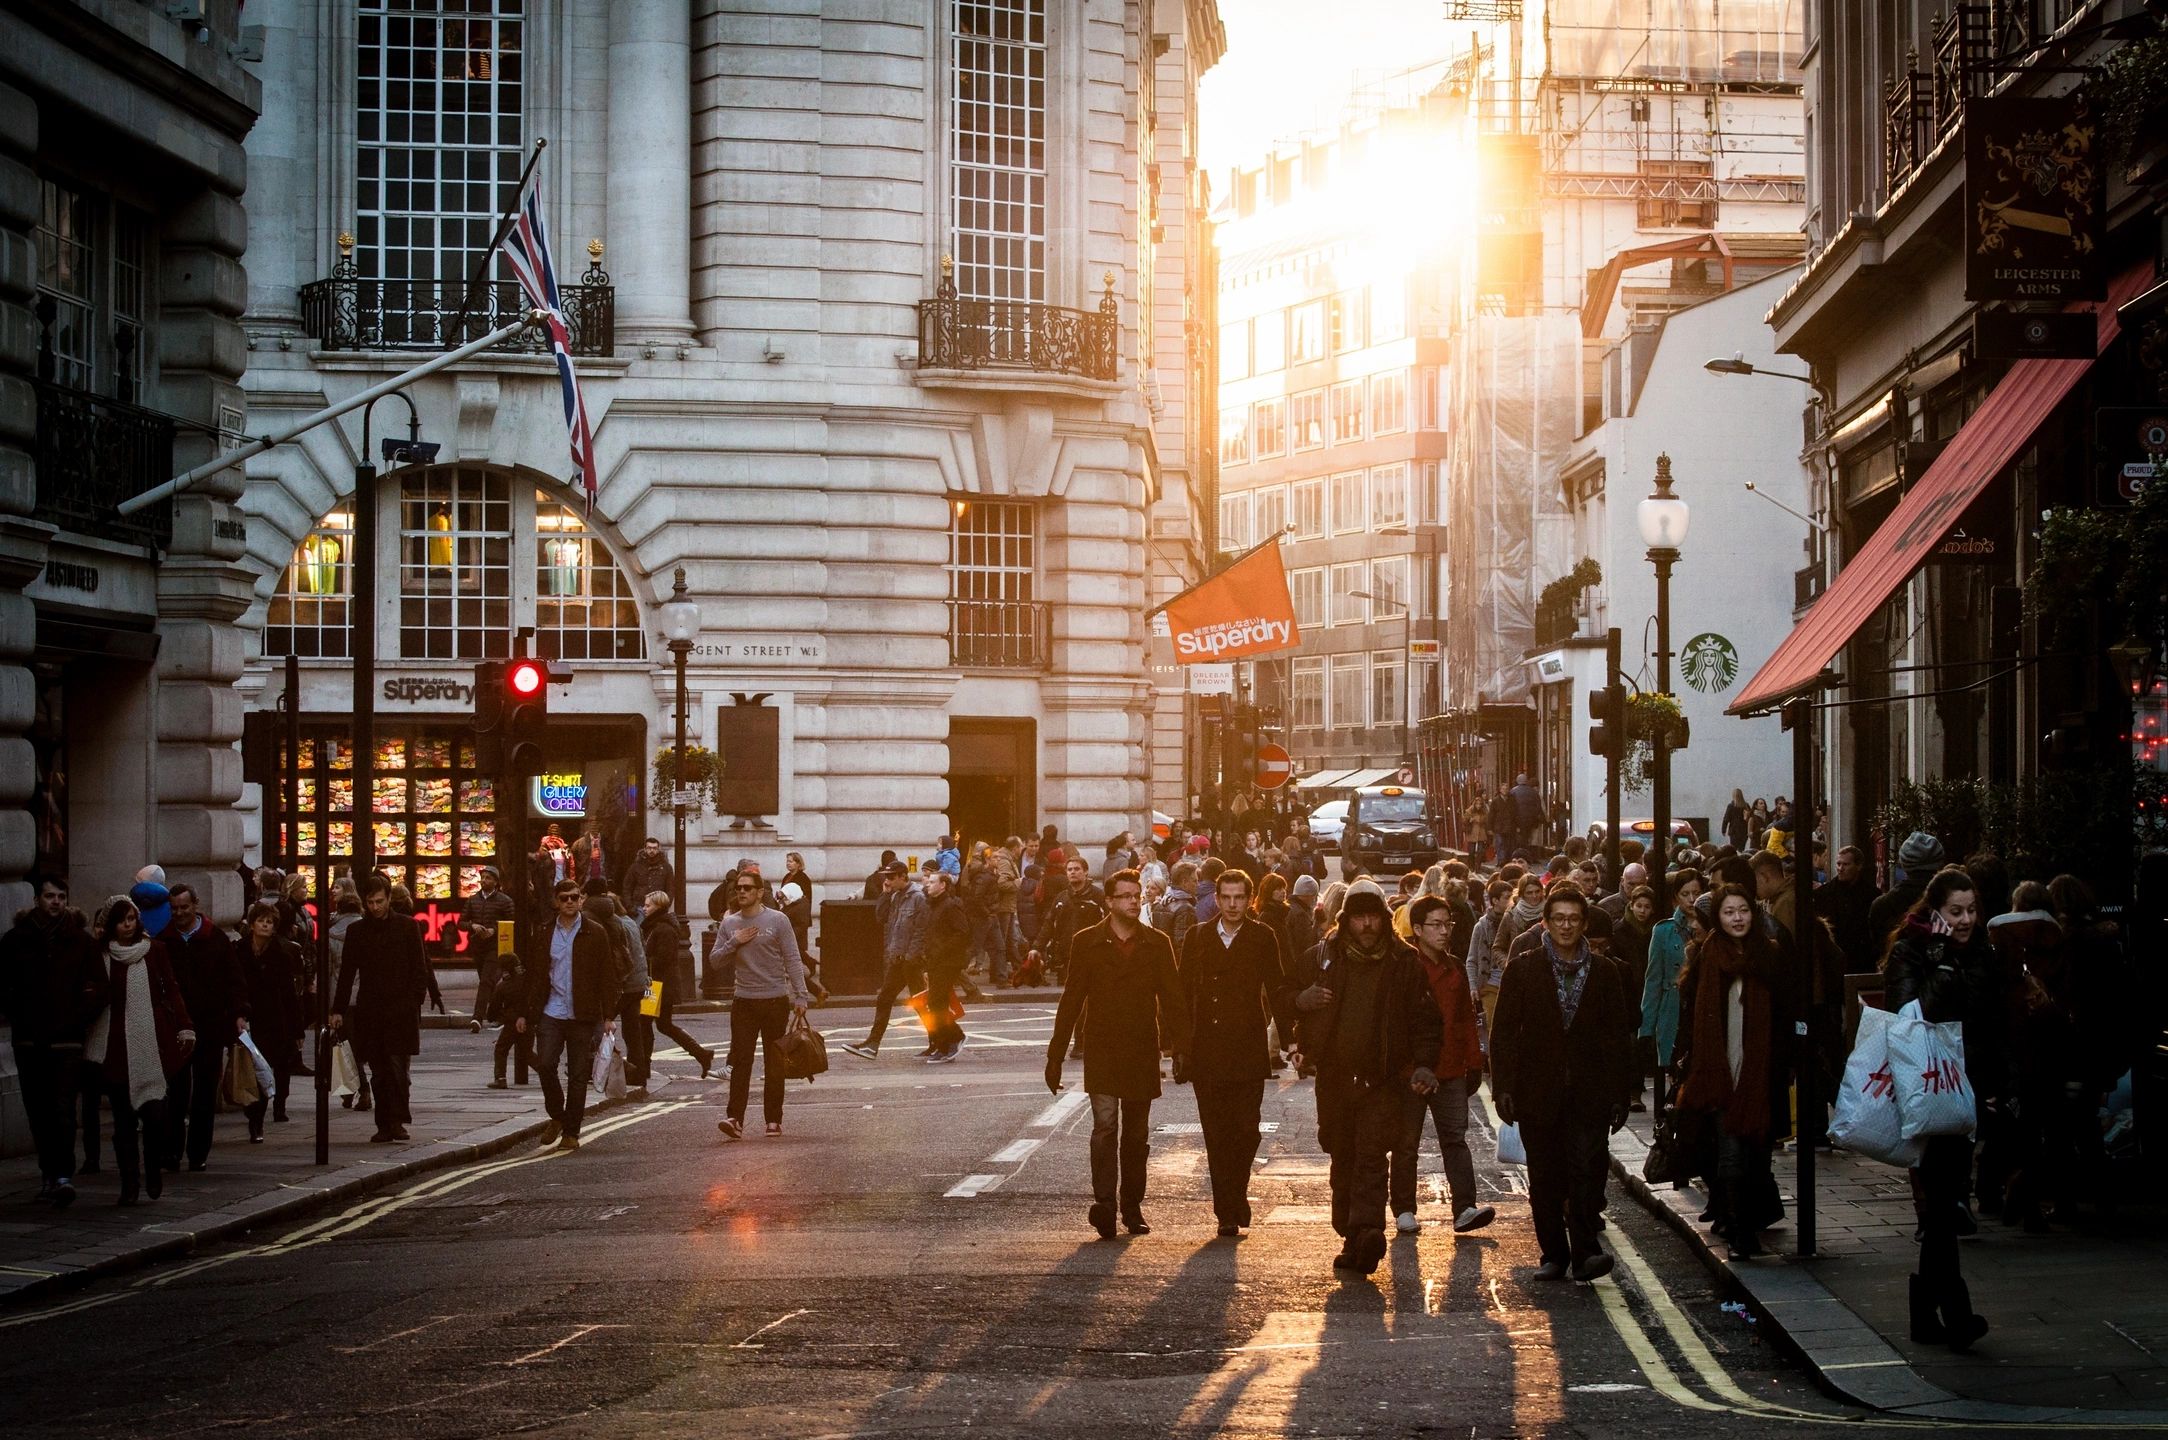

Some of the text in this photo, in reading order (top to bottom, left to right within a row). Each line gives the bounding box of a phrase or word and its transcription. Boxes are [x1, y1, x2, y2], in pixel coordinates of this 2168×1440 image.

[1994, 268, 2081, 280] LEICESTER
[2016, 284, 2061, 295] ARMS
[1177, 618, 1290, 655] Superdry
[744, 646, 791, 656] STREET
[384, 679, 475, 704] Superdry
[541, 774, 582, 787] T-SHIRT
[2101, 905, 2124, 913] AWAY
[1921, 1056, 1964, 1096] H&M
